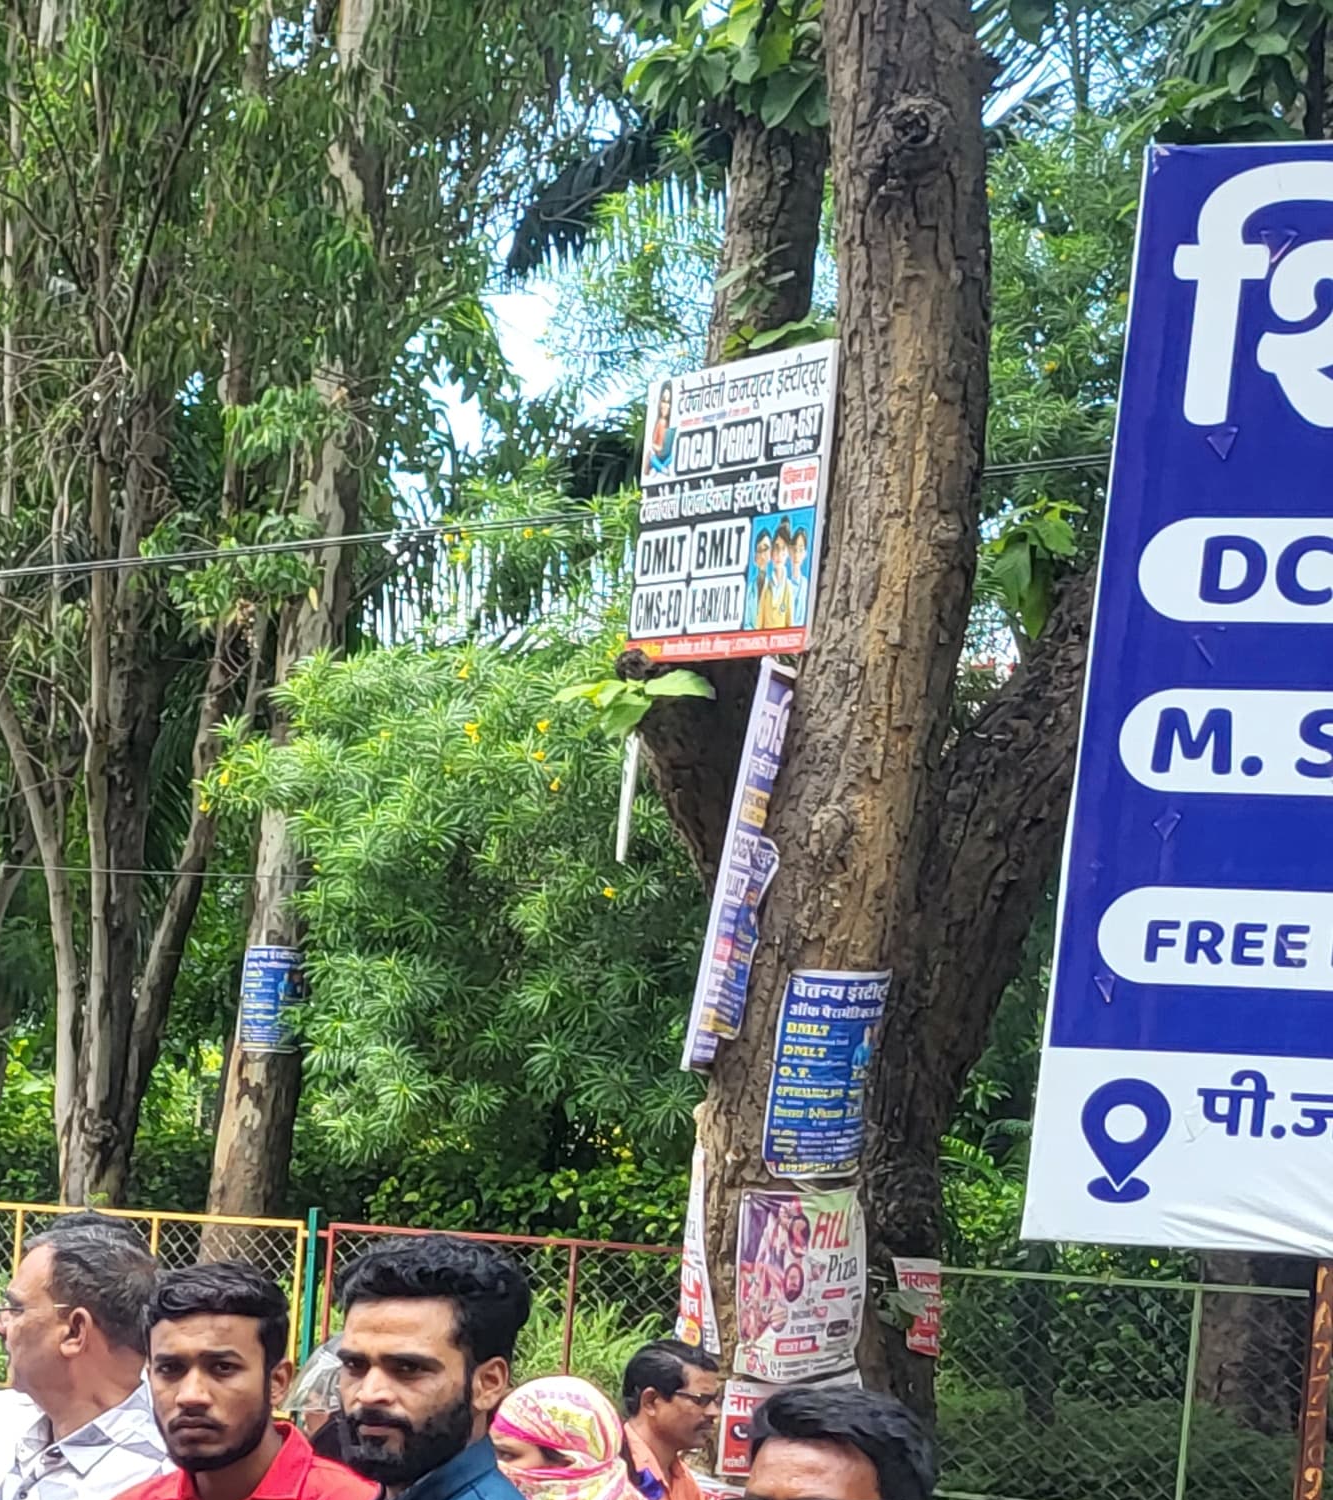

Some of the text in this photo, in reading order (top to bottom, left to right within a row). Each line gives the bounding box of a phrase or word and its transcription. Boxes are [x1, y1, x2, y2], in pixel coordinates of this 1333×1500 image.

[677, 431, 714, 471] DCA
[719, 422, 762, 464] PGDCA
[640, 525, 745, 577] DMLT BMLT
[1199, 535, 1333, 607] DC
[635, 589, 682, 632] CMS-ED
[1151, 707, 1263, 777] M.
[1144, 919, 1311, 968] FREE
[782, 1044, 828, 1059] DMLT
[785, 1021, 830, 1038] BMLT
